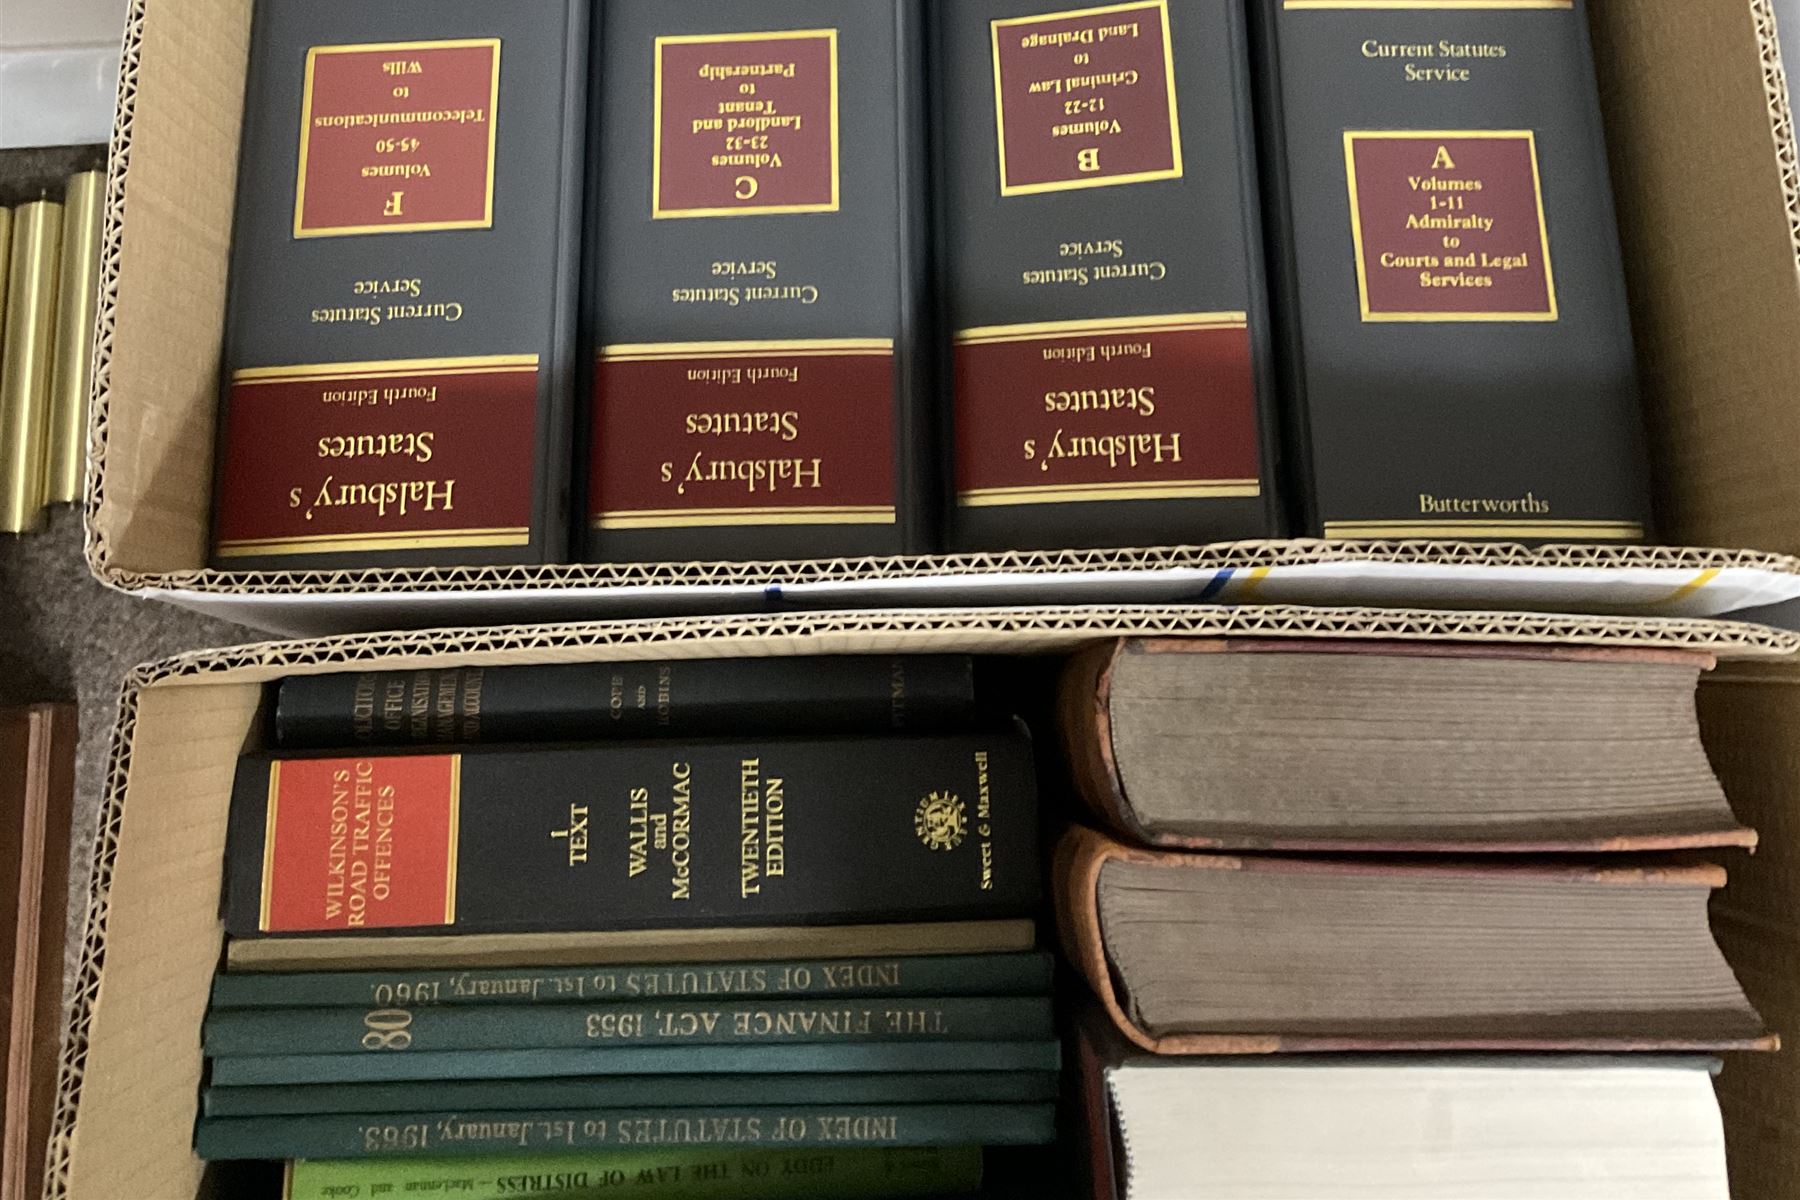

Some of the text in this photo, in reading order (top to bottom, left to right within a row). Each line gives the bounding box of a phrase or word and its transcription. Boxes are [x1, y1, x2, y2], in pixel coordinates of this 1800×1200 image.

[1021, 22, 1139, 49] Land Drainage
[1074, 53, 1090, 65] to
[1361, 39, 1506, 58] Current Statutes
[382, 61, 423, 76] Wills
[699, 63, 796, 80] Partnership
[1404, 64, 1469, 82] Service
[393, 86, 409, 98] to
[739, 83, 755, 95] to
[1028, 70, 1139, 94] Criminal Law
[718, 100, 777, 115] Tenant
[1064, 97, 1105, 115] 12-22
[315, 108, 485, 129] Telecommunications
[692, 115, 802, 133] Landlord and
[1052, 119, 1122, 138] Volumes
[375, 138, 420, 153] 45-50
[725, 135, 769, 150] 23-32
[711, 152, 782, 168] Volumes
[1077, 148, 1101, 172] B
[1431, 145, 1456, 169] A
[361, 164, 431, 179] Volumes
[735, 175, 758, 200] C
[1408, 176, 1482, 191] Volumes
[384, 191, 405, 216] F
[1430, 195, 1464, 210] 1-11
[1405, 214, 1493, 232] Admiralty
[1059, 240, 1123, 259] Service
[1443, 235, 1460, 248] to
[711, 260, 777, 280] Service
[1380, 252, 1528, 268] Courts and Legal
[1023, 262, 1166, 286] Current Statutes
[1418, 271, 1492, 287] Services
[354, 278, 422, 299] Service
[672, 285, 818, 306] Current Statutes
[311, 302, 463, 326] Current Statutes
[1043, 342, 1151, 363] Fourth Edition
[687, 366, 799, 385] Fourth Edition
[323, 386, 437, 407] Fourth Edition
[1045, 387, 1155, 416] Statutes
[685, 411, 799, 441] Statutes
[318, 431, 434, 463] Statutes
[1023, 429, 1182, 472] Halsbury's
[661, 451, 822, 495] Halsbury's
[290, 475, 456, 520] Halsbury's
[1419, 492, 1550, 513] Butterworths
[974, 751, 991, 820] Maxwell
[570, 803, 589, 866] TEXT
[629, 787, 649, 878] WALLIS
[651, 813, 668, 850] and
[672, 762, 691, 901] McCORMAC
[741, 757, 760, 898] TWENTIETH
[766, 778, 785, 877] EDITION
[325, 769, 351, 920] WILKINSON'S
[347, 761, 374, 927] ROAD TRAFFIC
[373, 785, 396, 900] OFFENCES
[980, 847, 993, 890] Sweet
[594, 976, 616, 991] to
[628, 968, 767, 994] STATUTES
[778, 967, 811, 990] OF
[823, 963, 900, 988] INDEX
[586, 1009, 949, 1039] THE FINANCE ACT, 1953
[583, 1122, 607, 1139] to
[617, 1118, 761, 1144] STATUTES
[772, 1117, 807, 1142] OF
[817, 1115, 899, 1141] INDEX
[600, 1169, 626, 1187] OF
[635, 1166, 681, 1186] LAW
[696, 1160, 728, 1180] THE
[371, 1182, 394, 1198] and
[496, 1171, 588, 1194] DISTRESS
